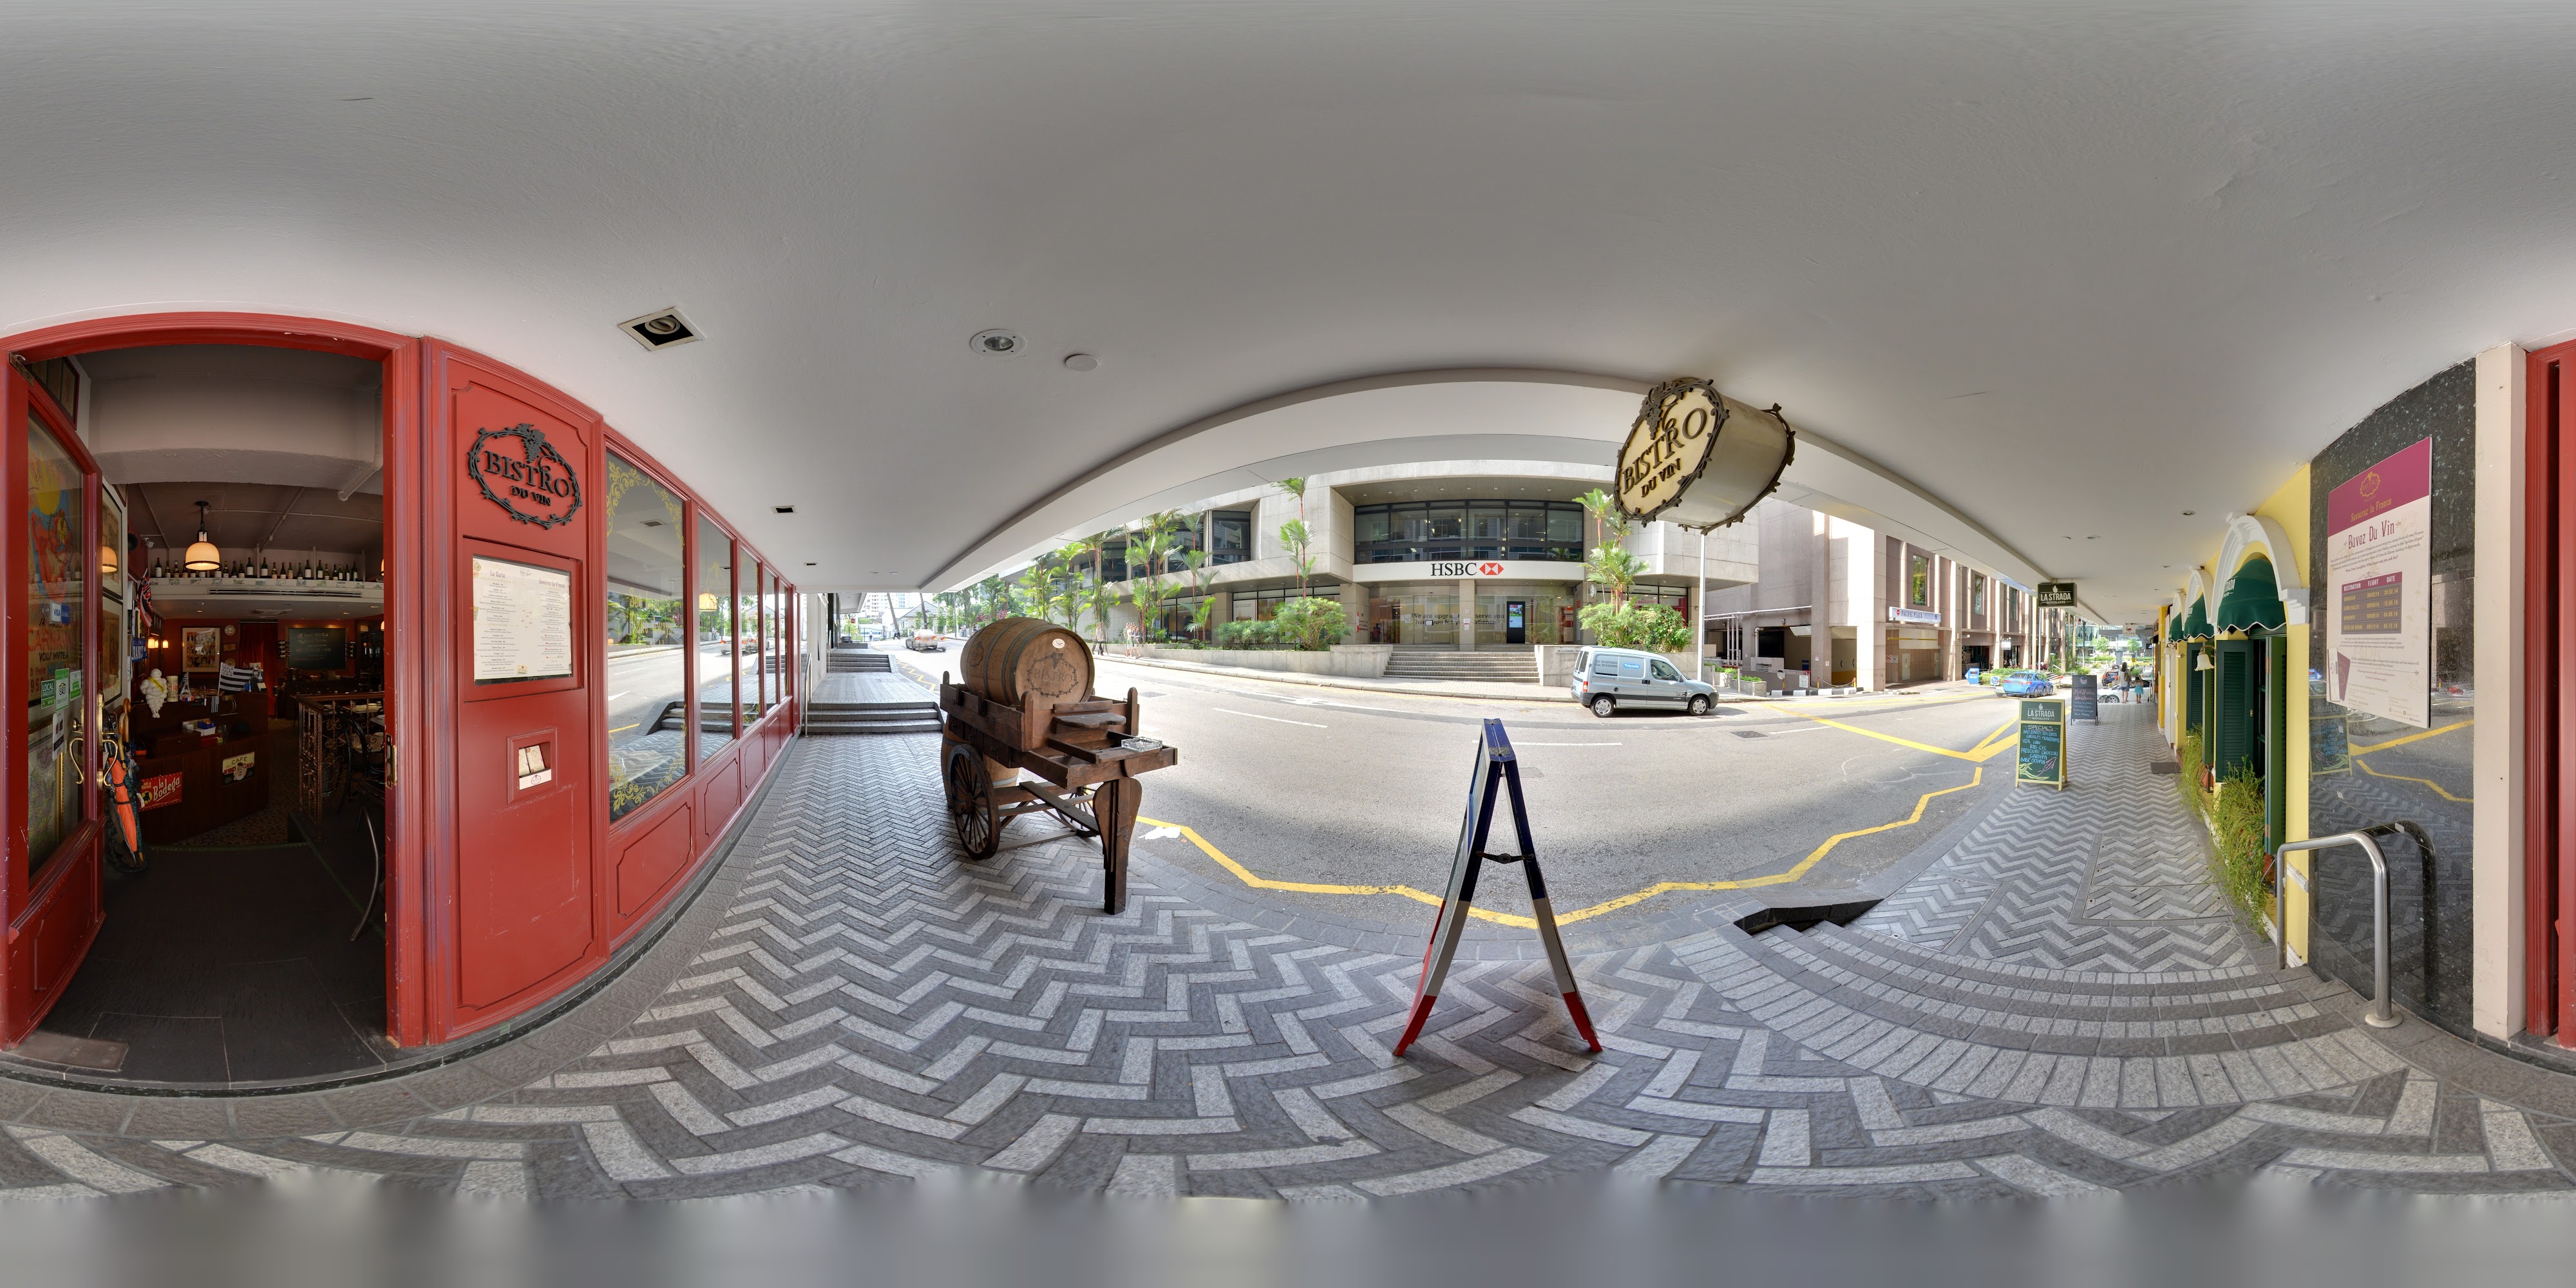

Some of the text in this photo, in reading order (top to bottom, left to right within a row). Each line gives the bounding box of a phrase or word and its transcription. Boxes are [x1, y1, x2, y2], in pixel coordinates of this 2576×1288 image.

[1622, 408, 1707, 495] BISTRO
[484, 451, 571, 497] BISTRO
[1641, 458, 1681, 498] DU VIN
[511, 486, 551, 506] DU VIN
[2351, 498, 2392, 522] Savourez la France
[2369, 526, 2377, 542] Du
[2382, 520, 2394, 537] Vin
[1431, 563, 1477, 576] HSBC
[2344, 583, 2361, 591] DESTINATION
[2049, 592, 2071, 601] STRADA
[39, 652, 52, 662] VOUS
[53, 652, 65, 660] INVITE
[1034, 668, 1072, 683] BISTRO
[43, 683, 53, 692] LOCAL
[232, 756, 248, 765] CAFÉ
[153, 777, 180, 802] Bodega
[159, 779, 164, 788] la
